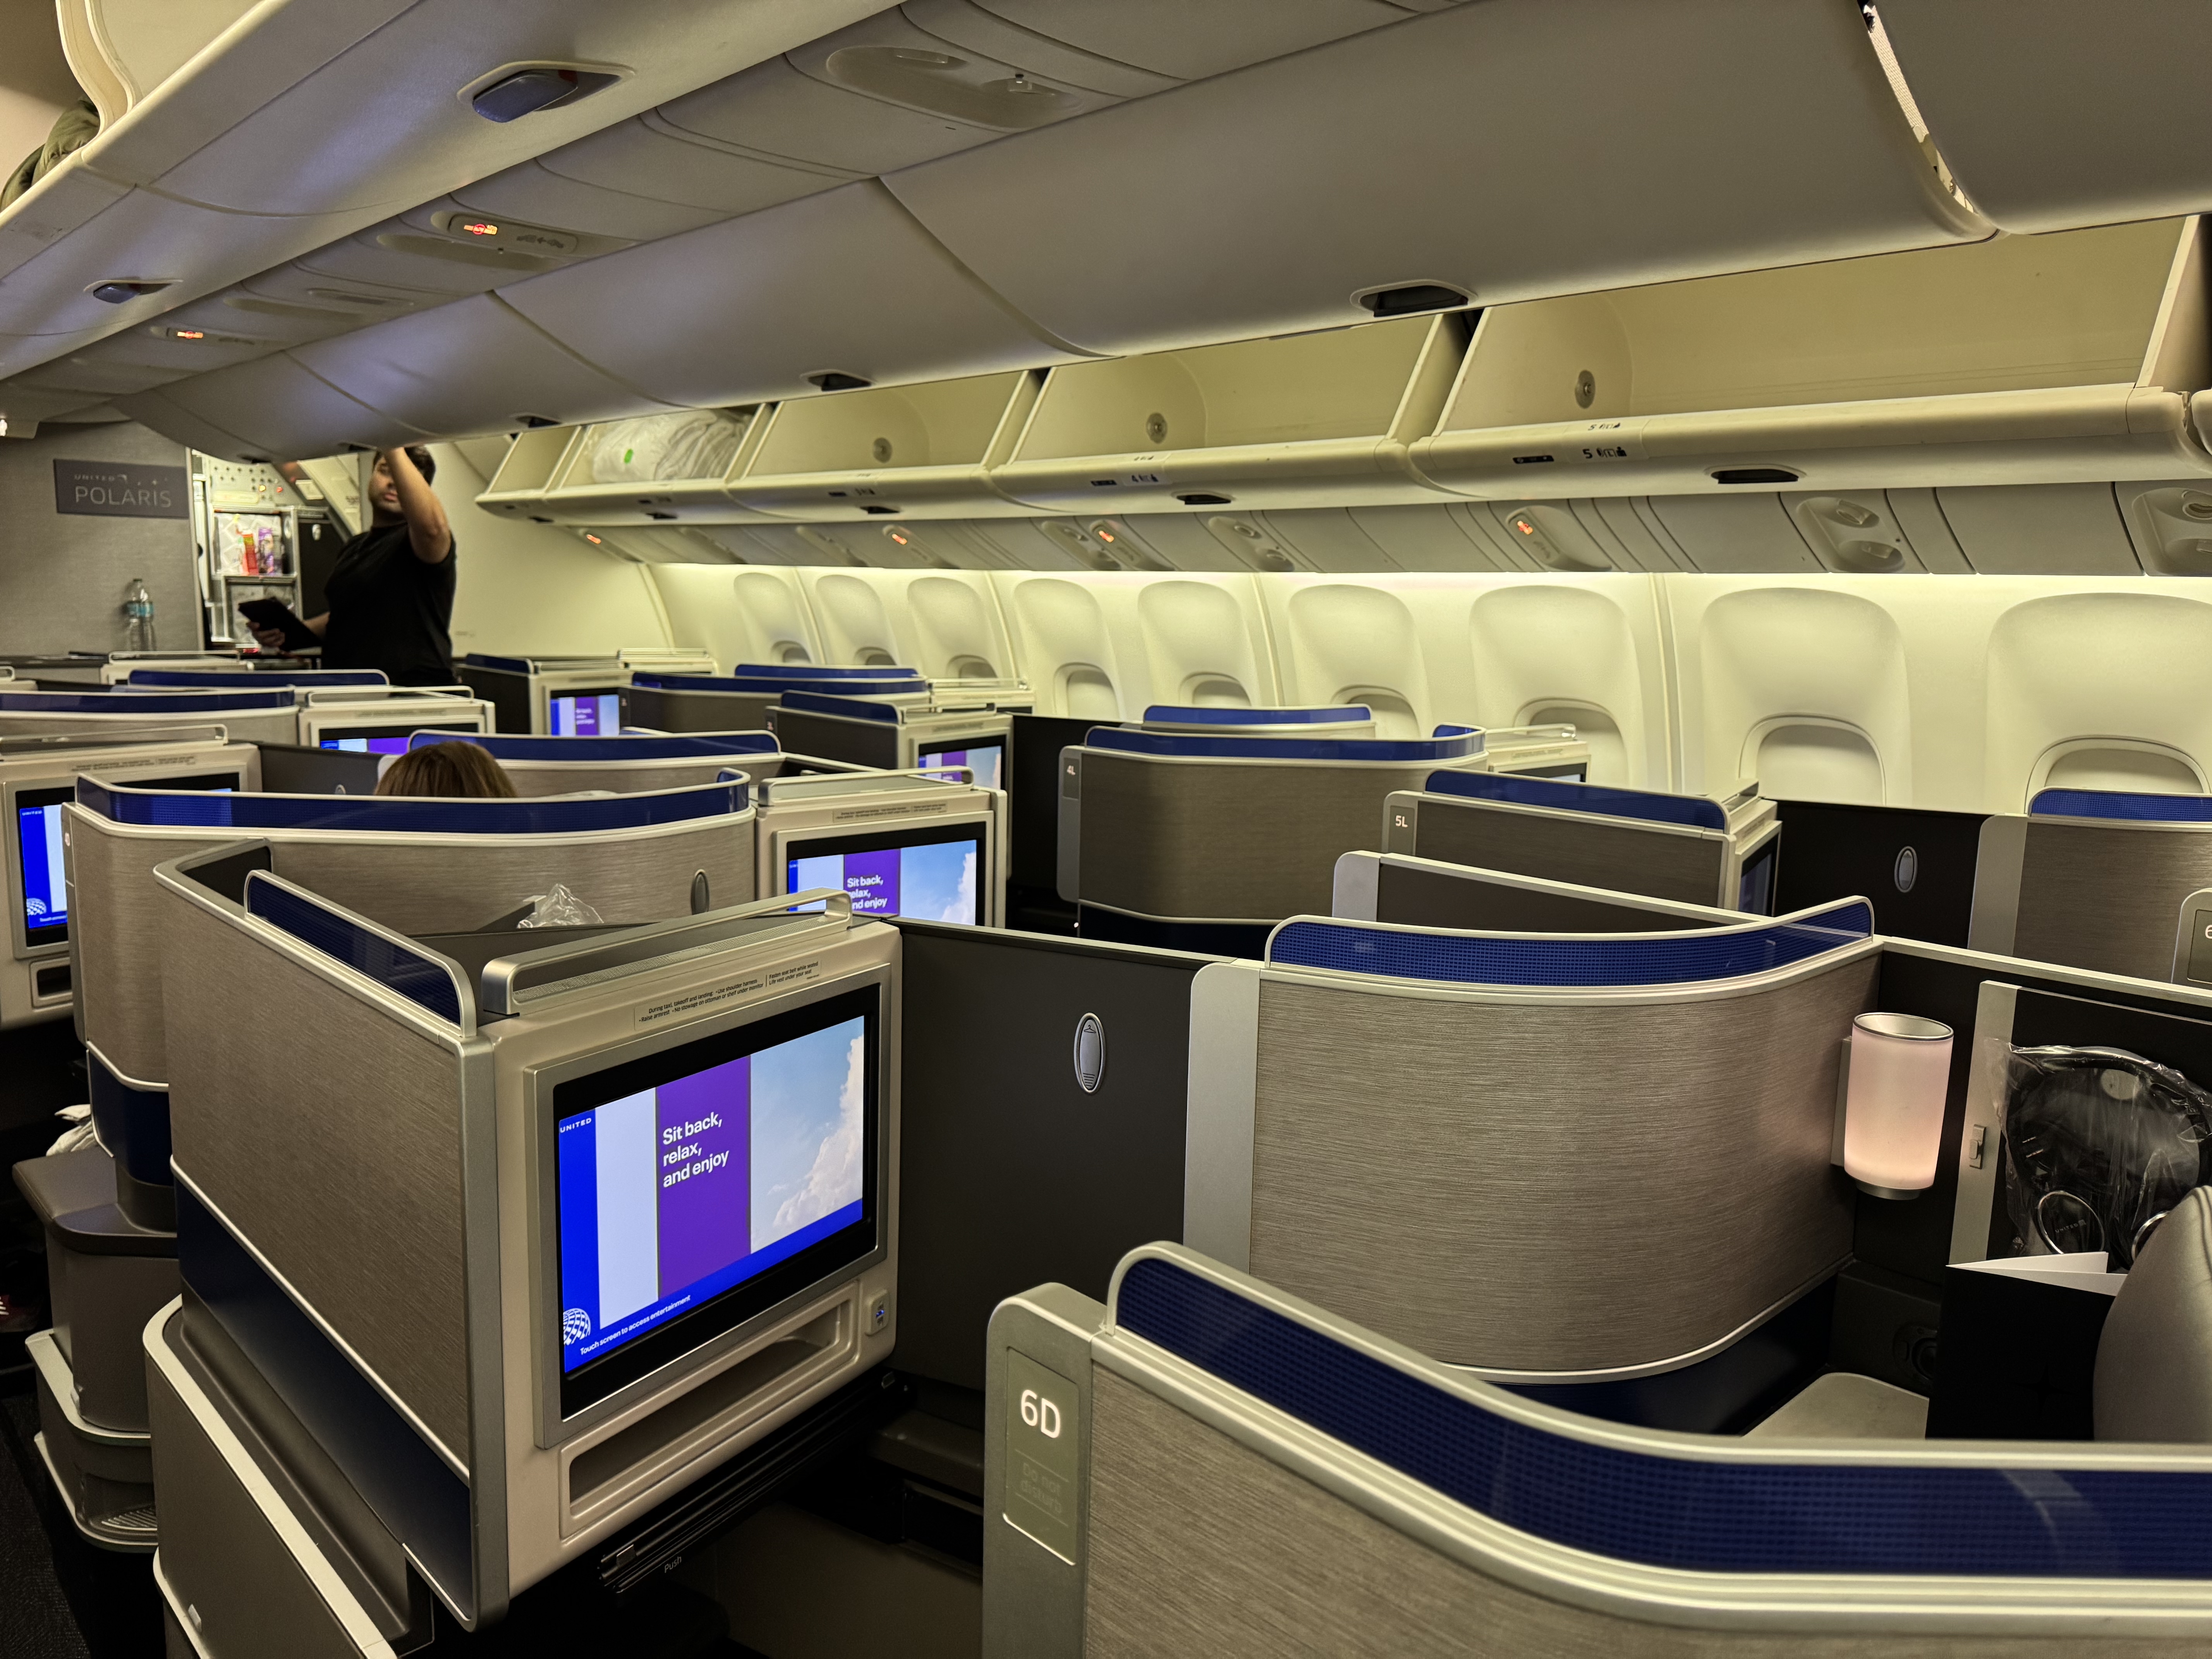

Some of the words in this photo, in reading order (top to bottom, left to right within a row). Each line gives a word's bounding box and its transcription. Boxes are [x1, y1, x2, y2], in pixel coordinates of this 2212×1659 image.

[1583, 448, 1592, 459] 5
[75, 486, 171, 508] POLARIS
[1396, 815, 1408, 827] 5L
[847, 878, 859, 888] Sit
[860, 874, 883, 886] back,
[852, 899, 864, 910] nd
[864, 897, 888, 909] enjoy
[674, 998, 689, 1006] takeoff
[726, 983, 742, 991] shoulder
[743, 979, 757, 987] harness
[654, 1010, 670, 1018] armrest
[681, 1002, 698, 1010] stowage
[705, 995, 721, 1004] ottoman
[559, 1117, 592, 1133] UNITED
[663, 1127, 683, 1145] Sit
[685, 1112, 723, 1138] back,
[663, 1142, 702, 1167] relax,
[663, 1163, 690, 1188] and
[692, 1150, 730, 1175] enjoy
[2055, 1223, 2078, 1233] UNITED
[580, 1341, 599, 1355] Touch
[599, 1329, 621, 1346] screen
[628, 1315, 650, 1331] access
[650, 1295, 691, 1320] entertainment
[1020, 1389, 1061, 1439] 6D
[1023, 1462, 1038, 1482] Do
[1041, 1476, 1061, 1497] not
[665, 1556, 682, 1573] Push
